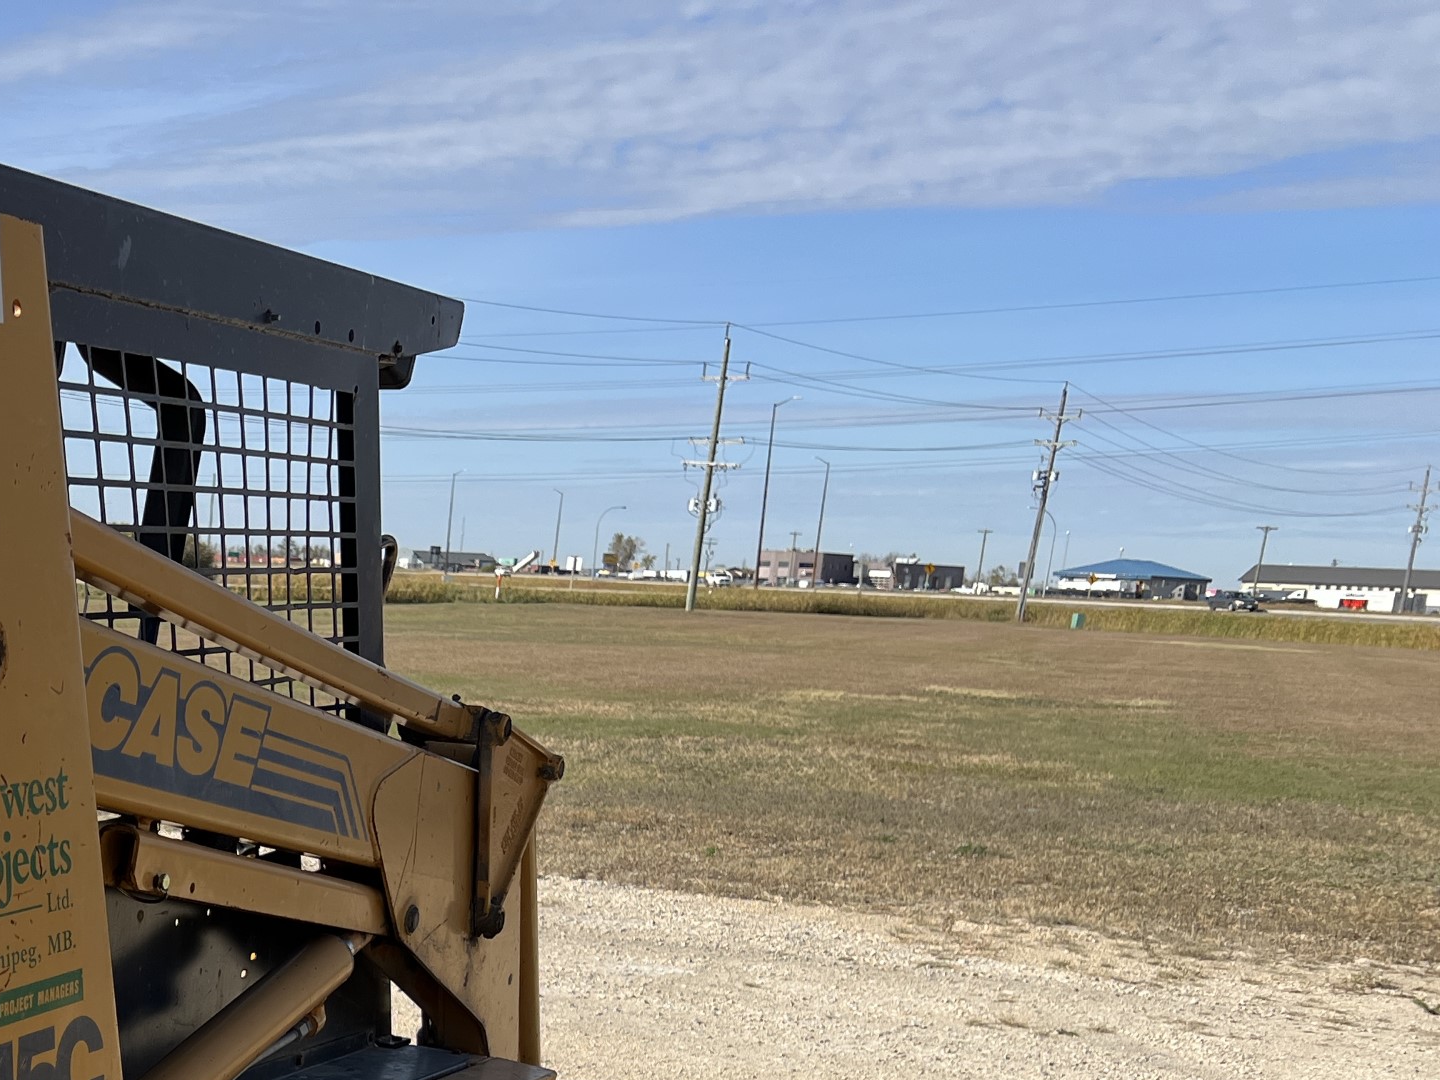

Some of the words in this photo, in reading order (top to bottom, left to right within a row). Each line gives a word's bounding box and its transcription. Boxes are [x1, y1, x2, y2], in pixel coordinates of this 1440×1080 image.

[84, 648, 272, 790] CASE
[46, 888, 74, 914] Ltd.
[48, 929, 77, 957] MB.
[37, 980, 80, 1006] MANAGERS
